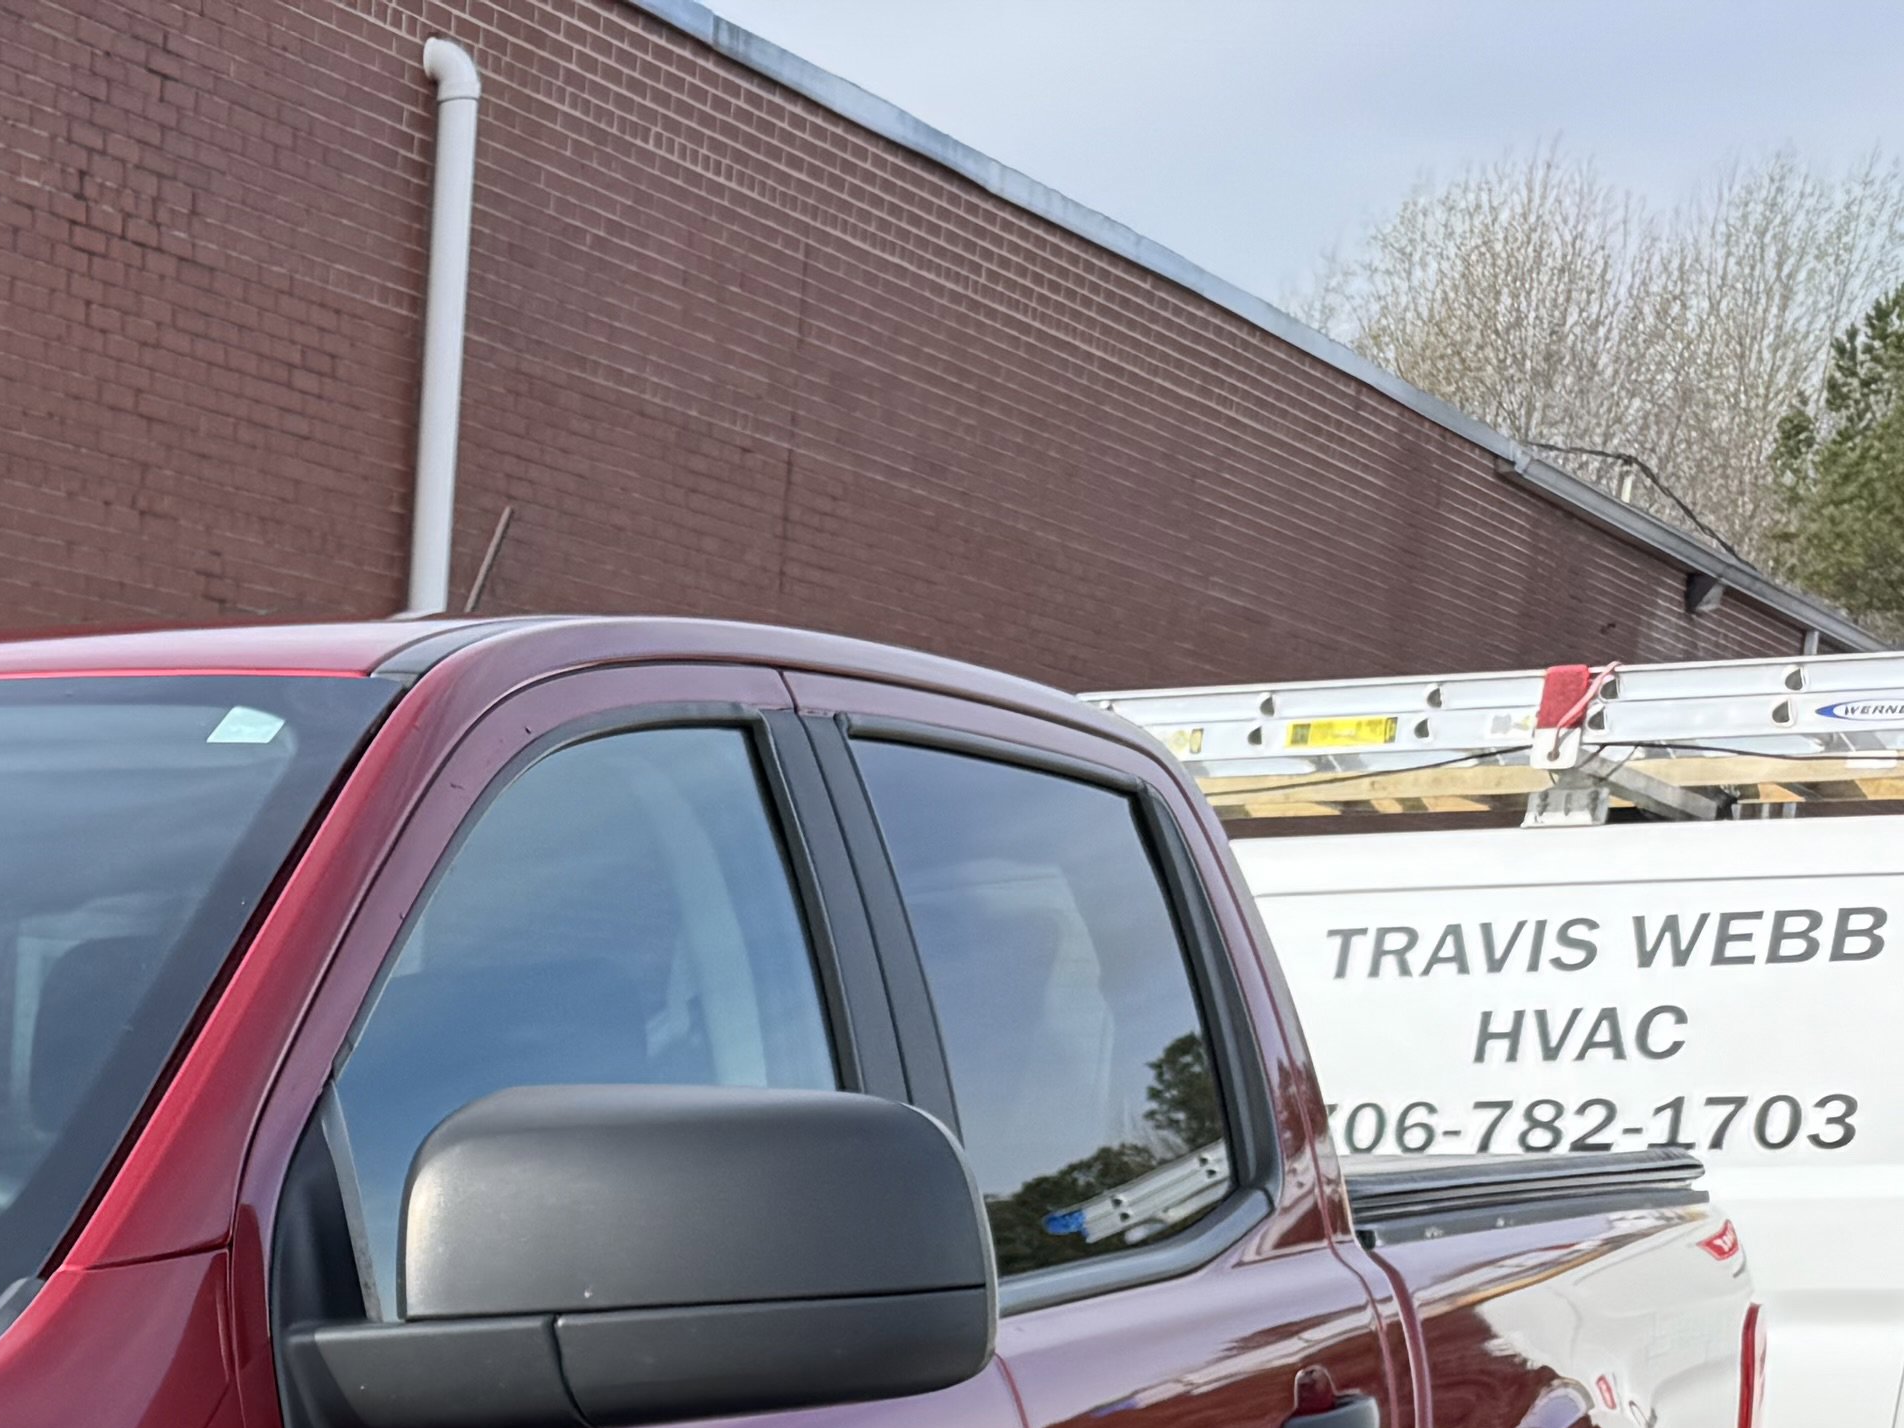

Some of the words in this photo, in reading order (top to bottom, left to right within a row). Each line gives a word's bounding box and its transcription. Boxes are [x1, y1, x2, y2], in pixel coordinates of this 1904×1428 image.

[1326, 917, 1601, 979] TRAVIS
[1632, 906, 1889, 968] WEBB
[1472, 1004, 1689, 1064] HVAC
